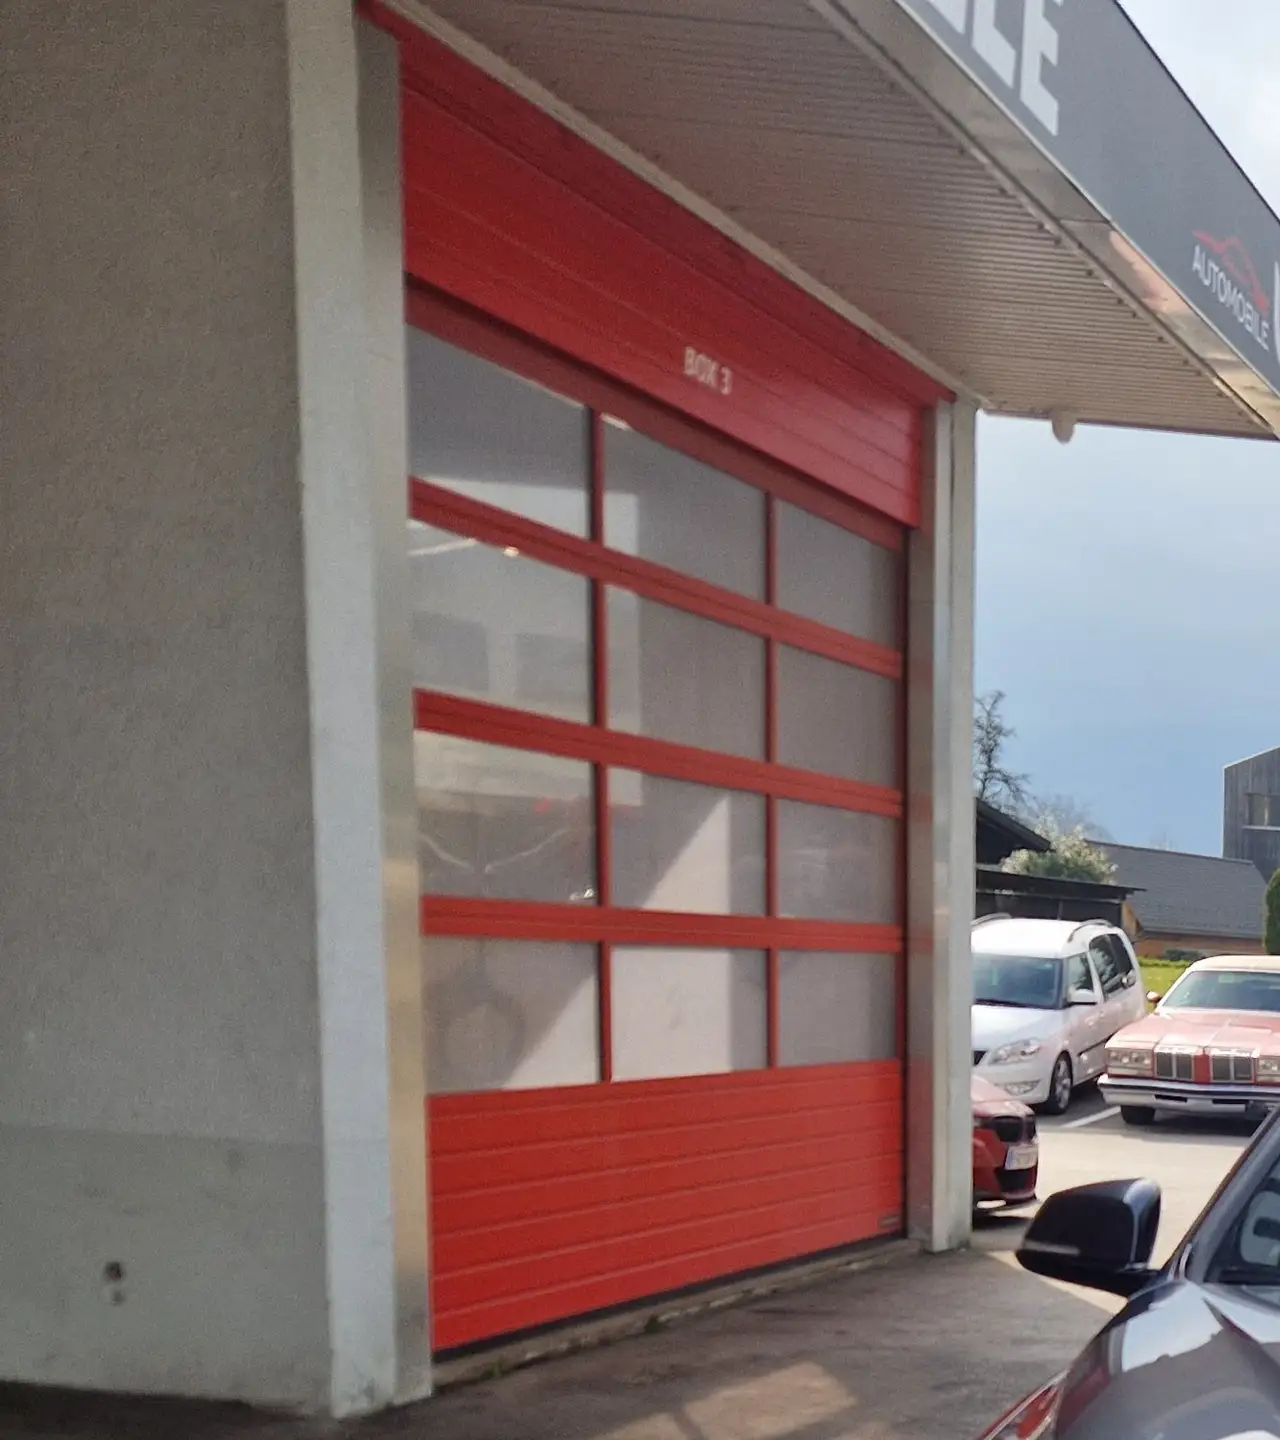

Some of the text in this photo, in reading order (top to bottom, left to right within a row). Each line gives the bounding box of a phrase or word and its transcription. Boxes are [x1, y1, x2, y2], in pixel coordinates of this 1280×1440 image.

[1192, 244, 1271, 352] AUTOMOBILE
[684, 346, 734, 395] BOX 3
